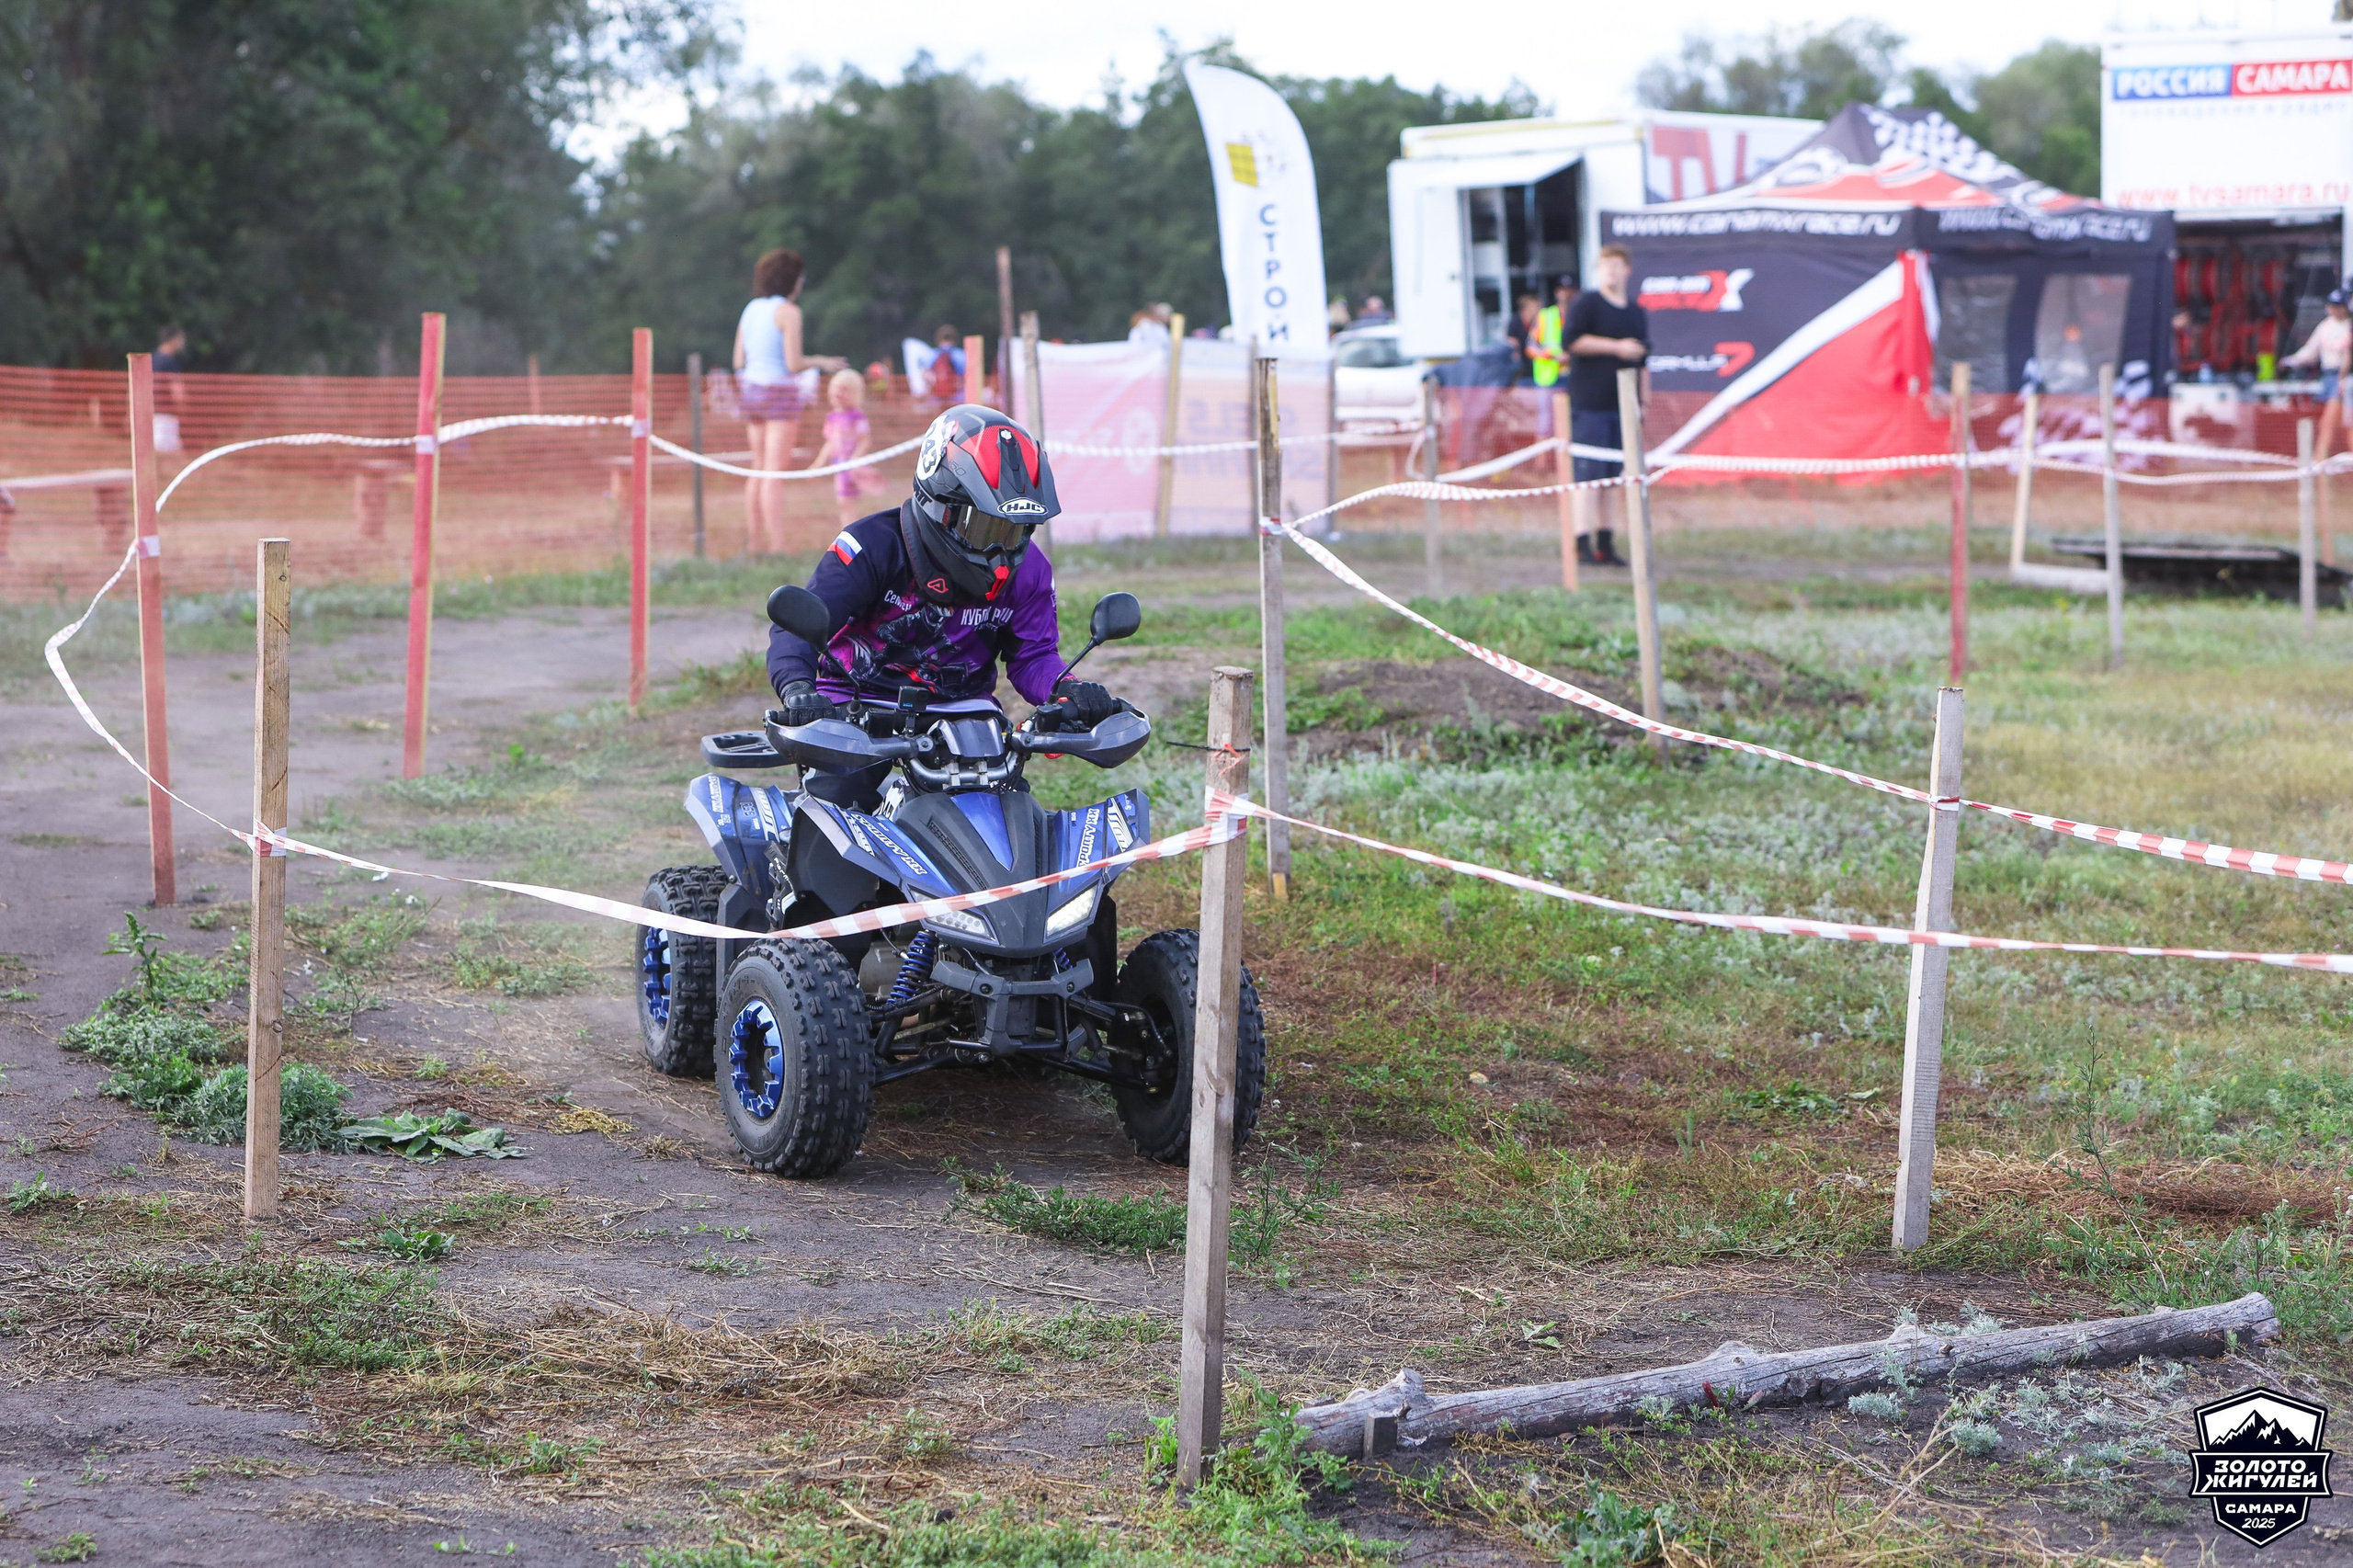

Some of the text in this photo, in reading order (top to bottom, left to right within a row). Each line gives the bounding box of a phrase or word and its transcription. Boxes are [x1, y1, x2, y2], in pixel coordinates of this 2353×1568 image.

[2116, 62, 2350, 98] РОССИЯ САМАРА
[1006, 502, 1043, 512] HJC
